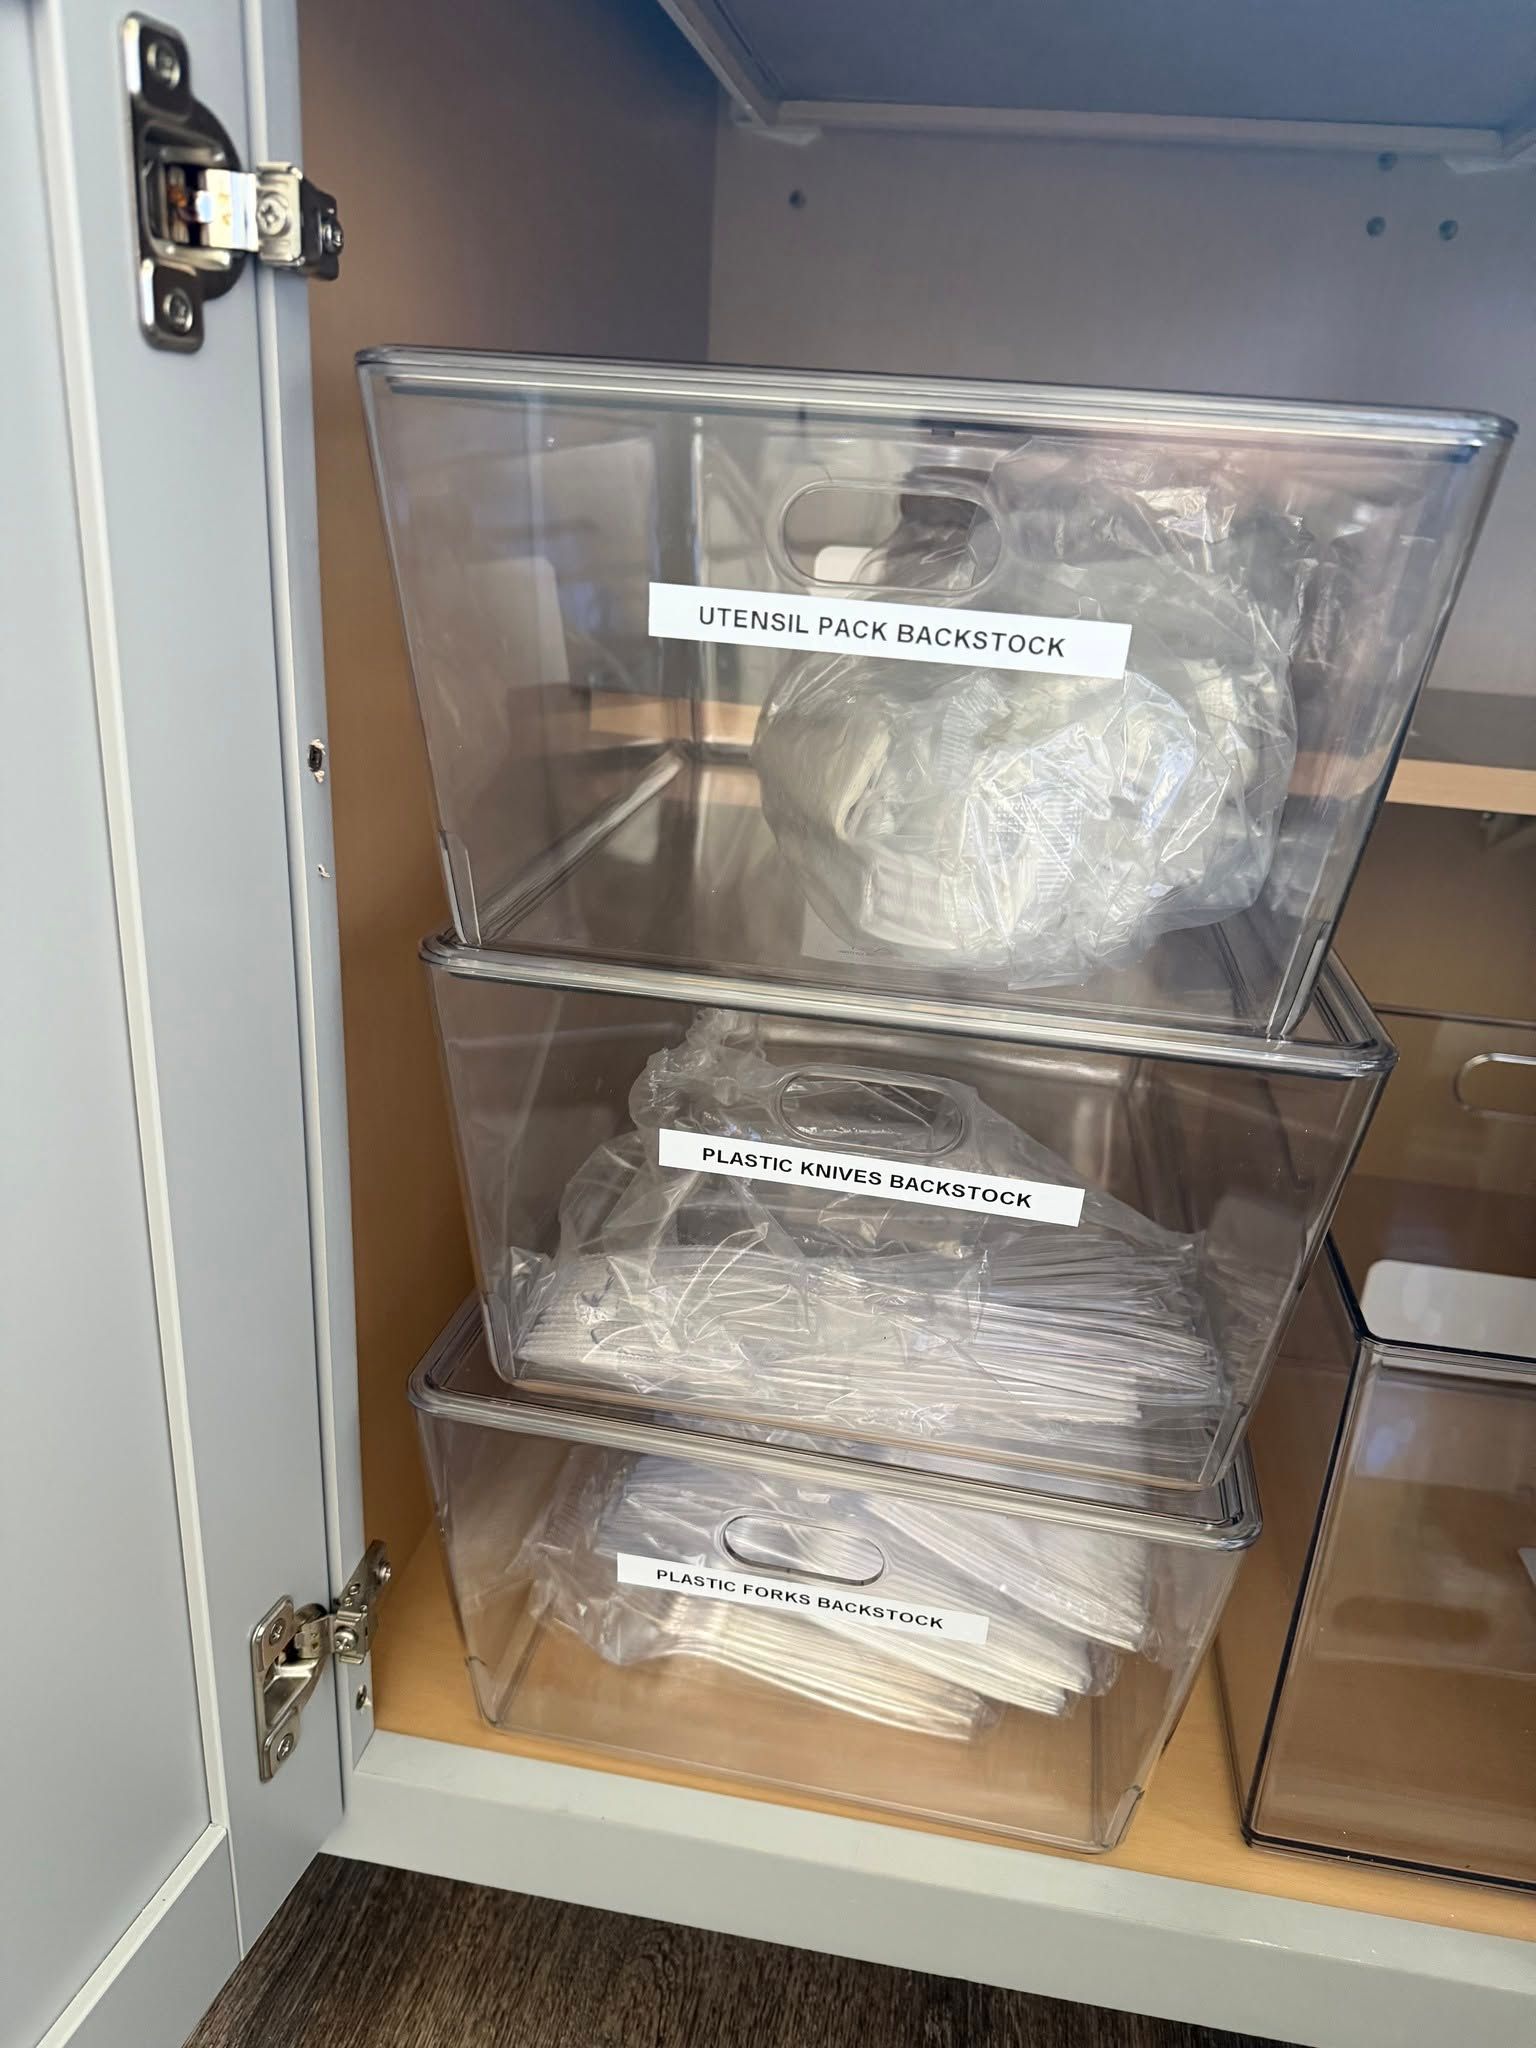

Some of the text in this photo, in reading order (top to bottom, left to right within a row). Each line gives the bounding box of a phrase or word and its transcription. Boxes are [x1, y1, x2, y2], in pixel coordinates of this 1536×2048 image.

[699, 605, 1065, 657] UTENSIL PACK BACKSTOCK
[702, 1147, 1032, 1209] PLASTIC KNIVES BACKSTOCK
[656, 1569, 943, 1630] PLASTIC FORKS BACKSTOCK
